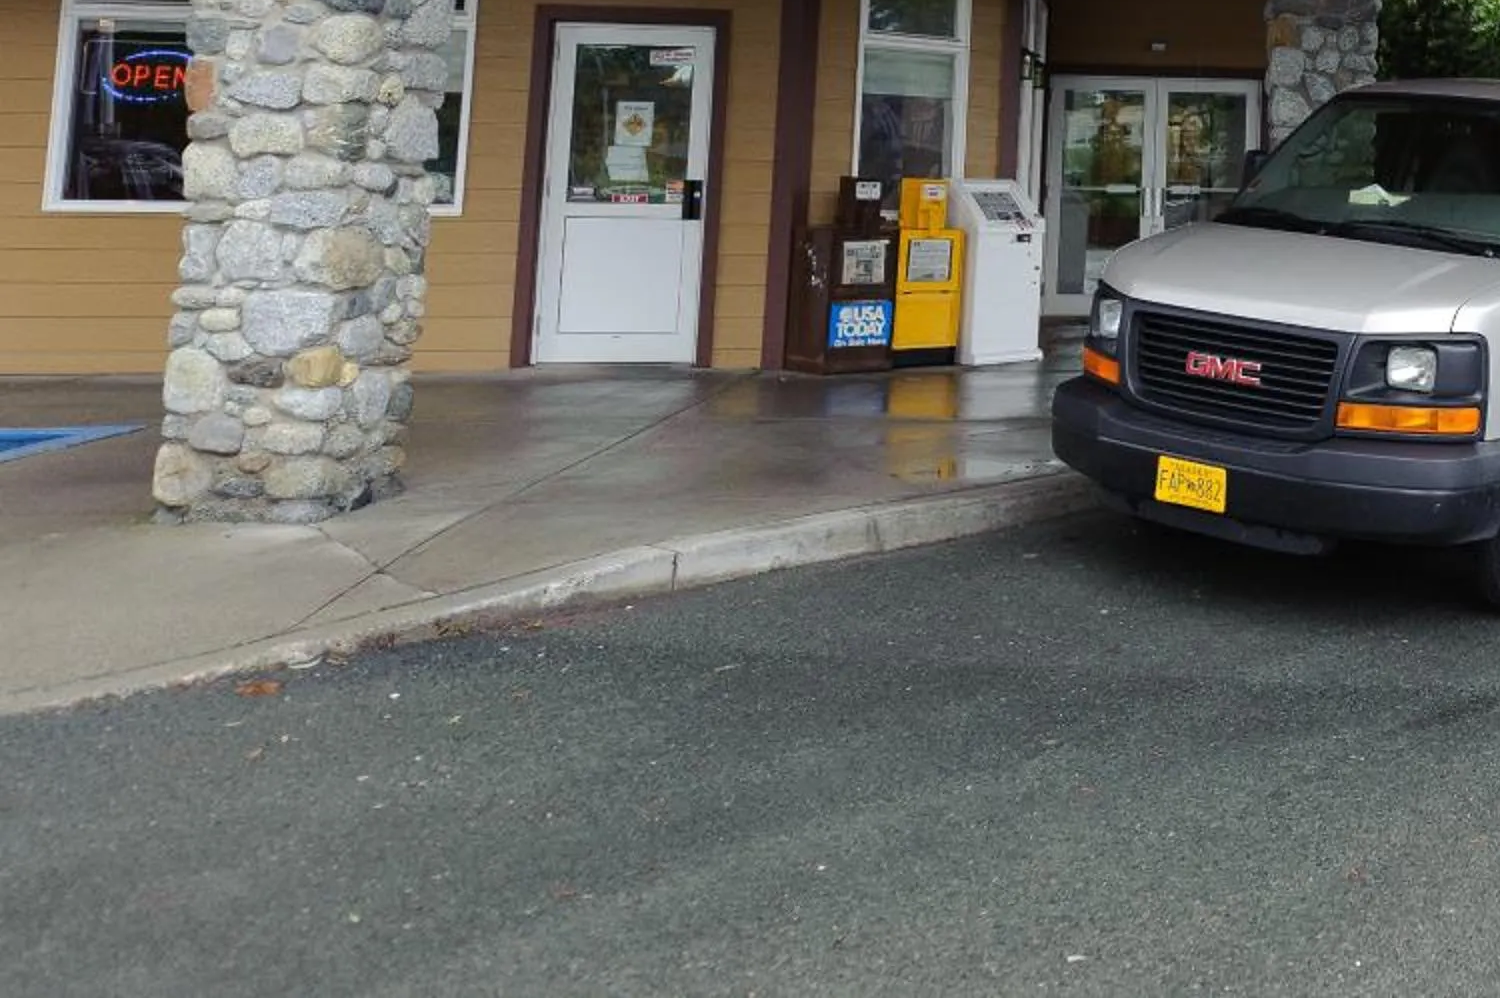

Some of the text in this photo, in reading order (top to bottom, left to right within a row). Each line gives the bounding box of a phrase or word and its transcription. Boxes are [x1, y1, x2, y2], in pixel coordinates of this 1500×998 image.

[110, 62, 187, 89] OPEN
[851, 305, 886, 321] USA
[836, 321, 887, 338] TODAY
[1186, 351, 1262, 387] GMC
